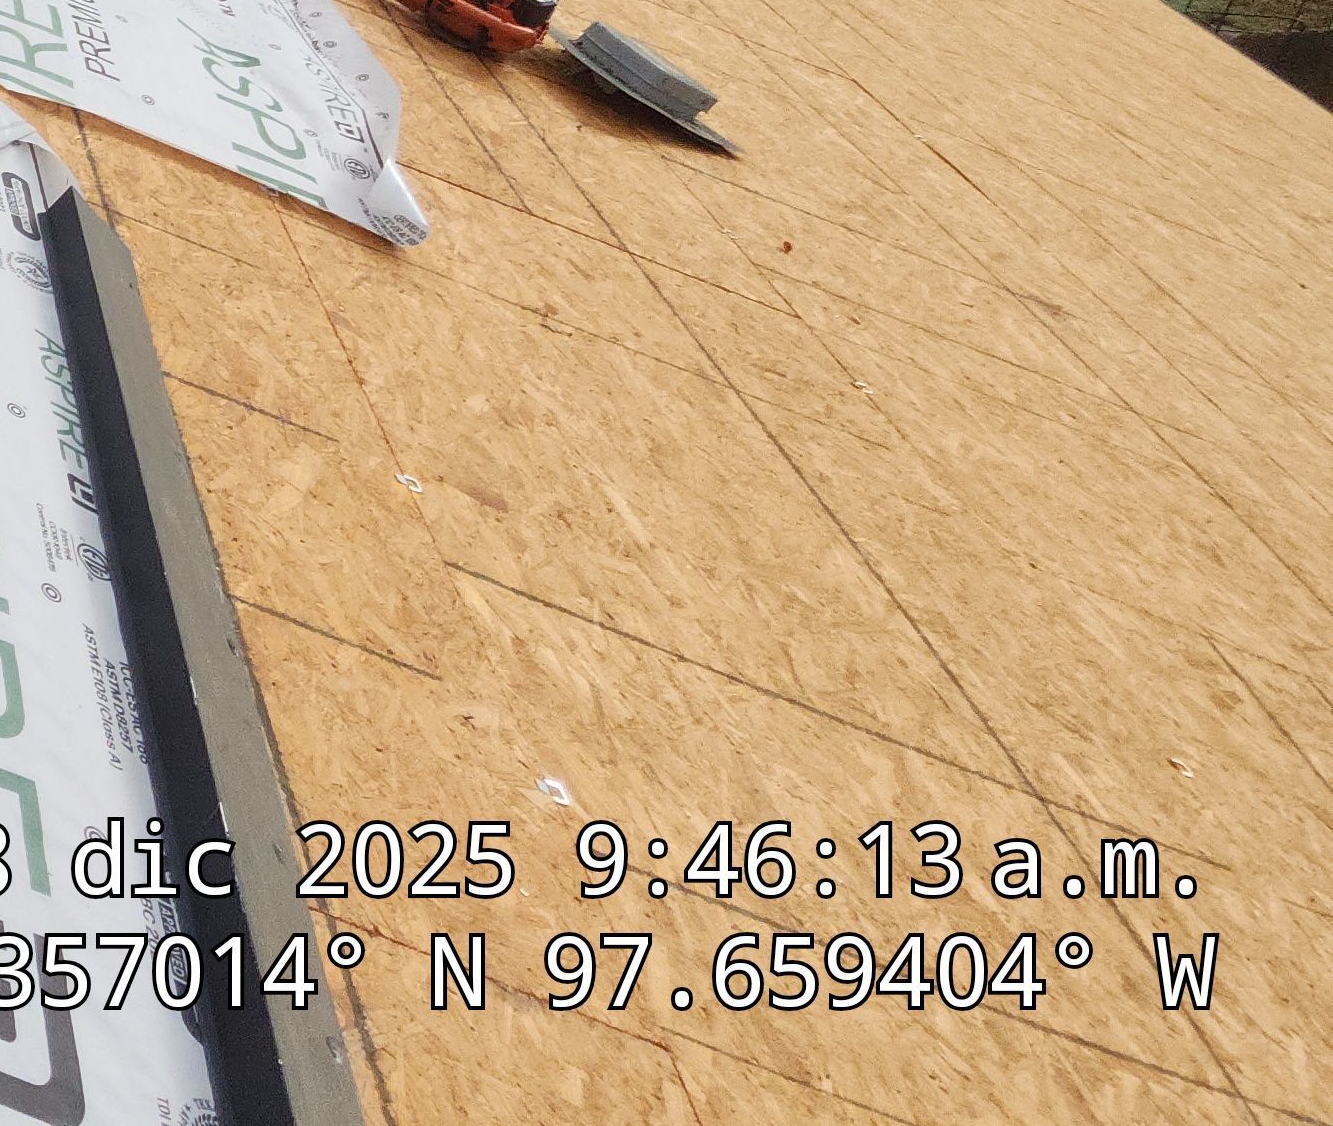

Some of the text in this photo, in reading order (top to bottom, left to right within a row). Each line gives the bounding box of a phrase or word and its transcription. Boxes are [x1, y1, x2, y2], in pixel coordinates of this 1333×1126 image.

[83, 623, 123, 771] ASTM E108 (Class A)
[104, 658, 133, 754] ASTM D8257
[157, 1096, 172, 1121] TDI
